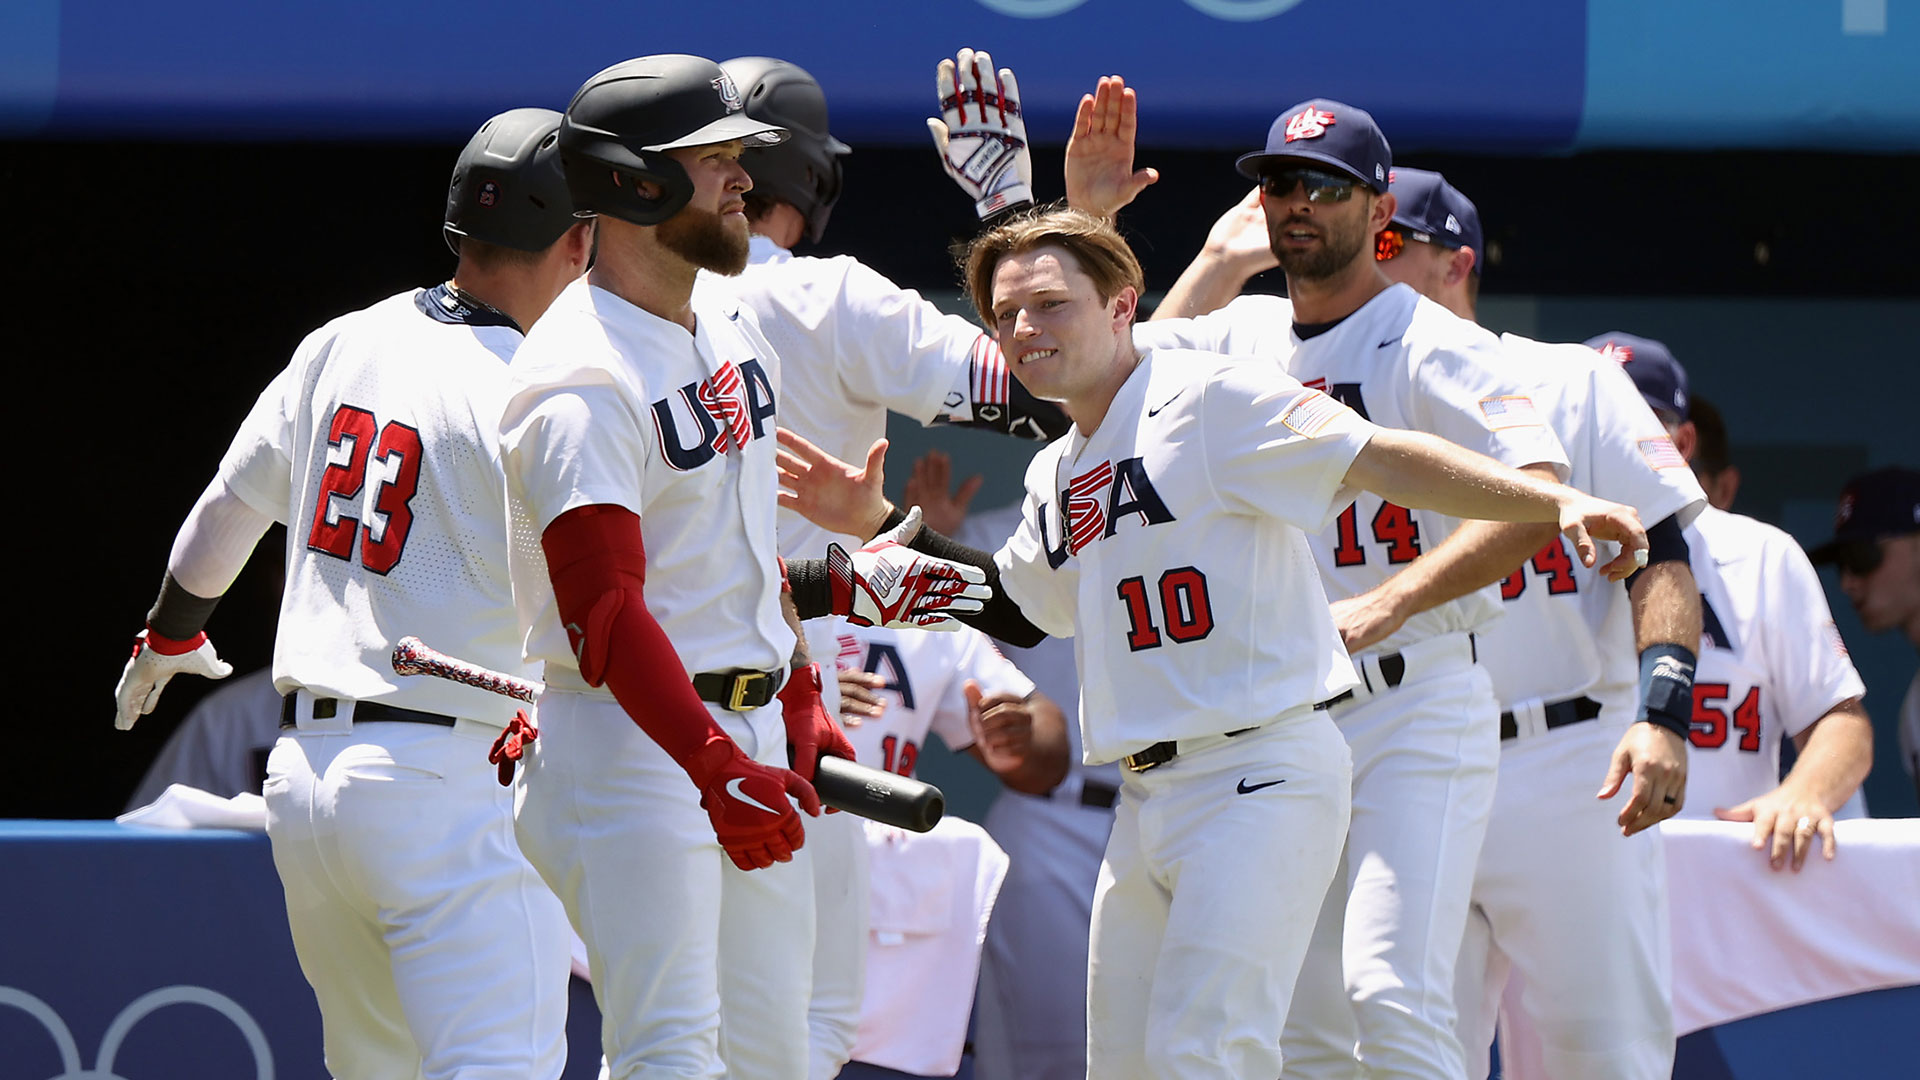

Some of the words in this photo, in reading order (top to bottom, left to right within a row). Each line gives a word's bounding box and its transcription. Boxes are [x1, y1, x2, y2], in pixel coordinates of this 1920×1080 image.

[650, 358, 776, 471] USA
[307, 403, 424, 577] 23
[1038, 456, 1177, 570] USA
[1334, 500, 1422, 567] 14
[1117, 566, 1214, 652] 10
[1688, 683, 1760, 752] 54
